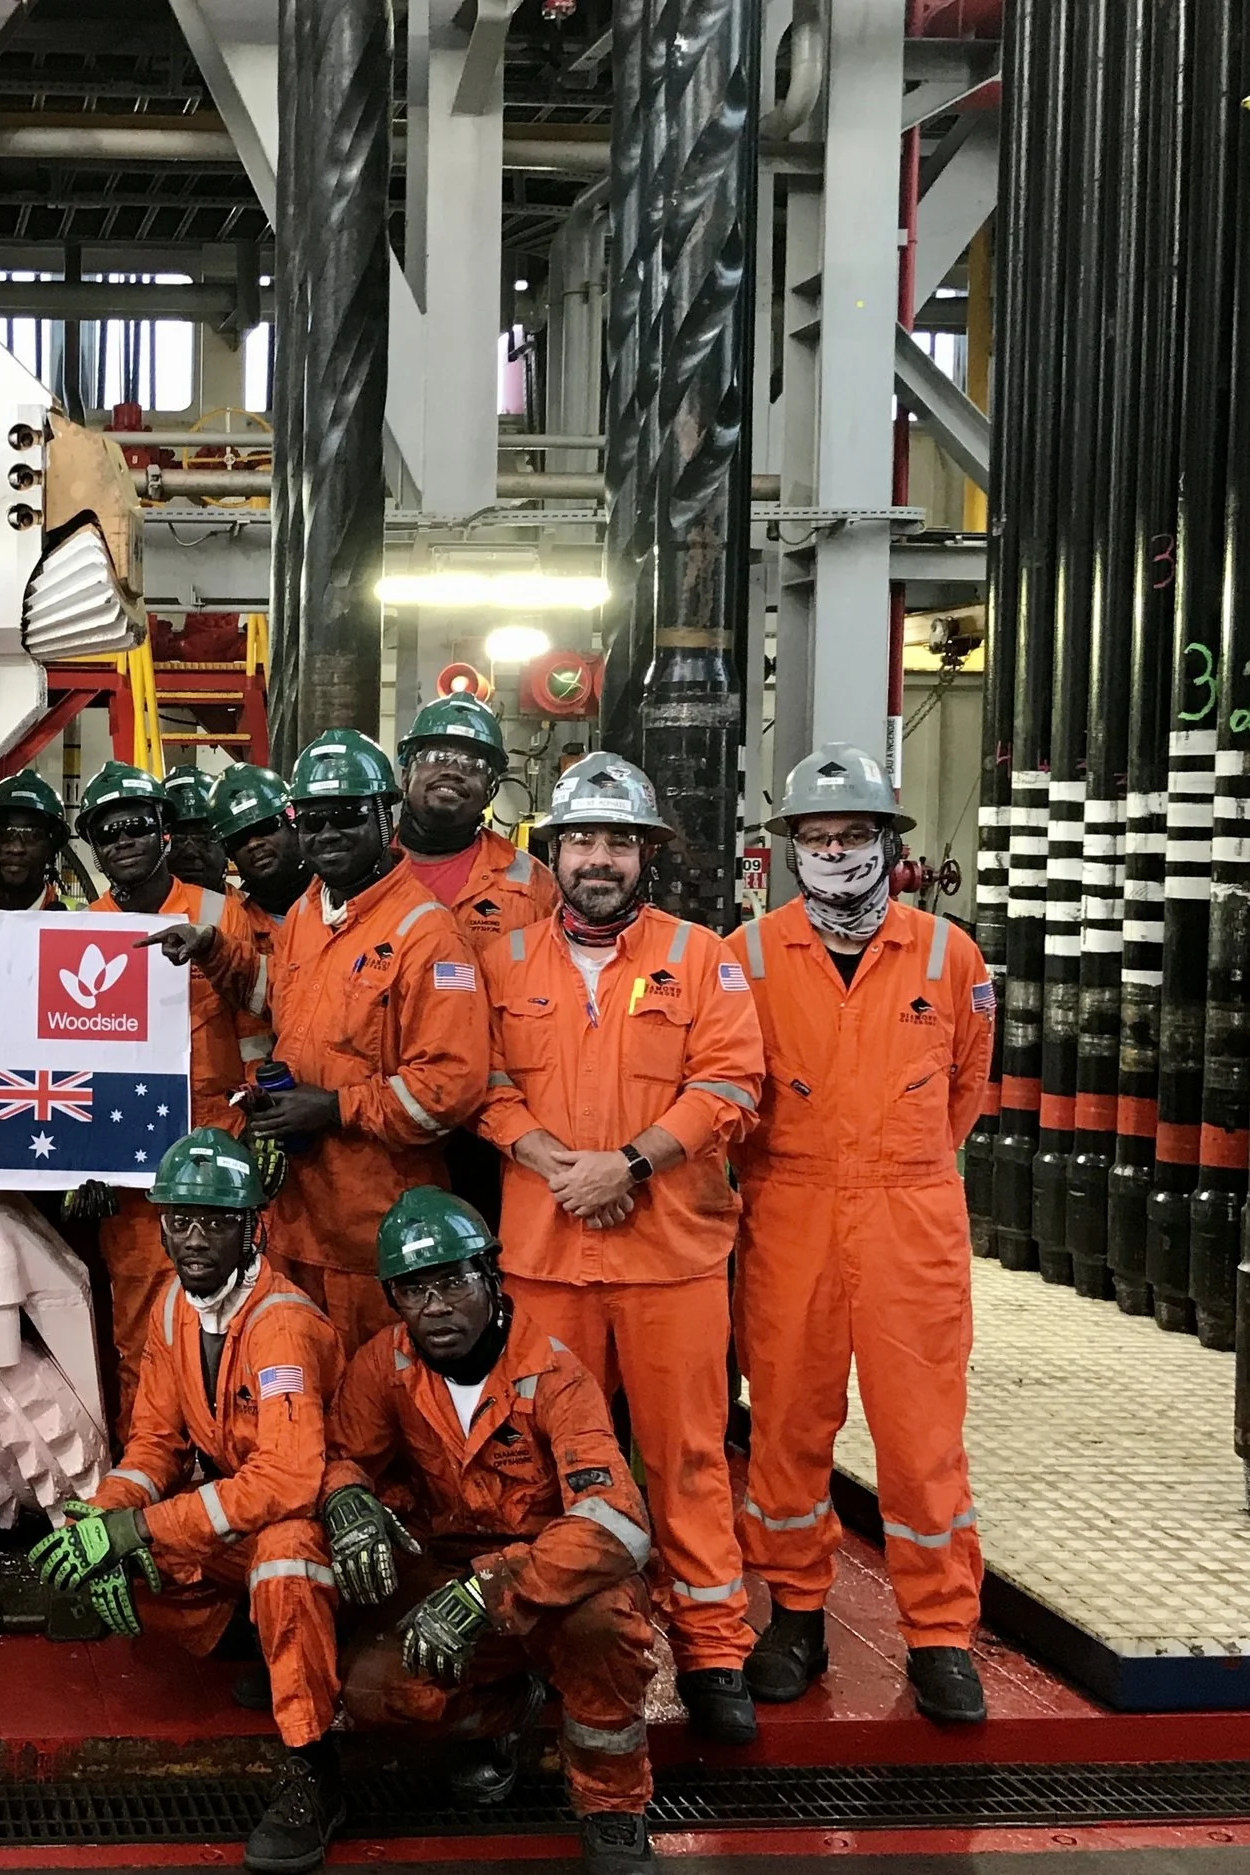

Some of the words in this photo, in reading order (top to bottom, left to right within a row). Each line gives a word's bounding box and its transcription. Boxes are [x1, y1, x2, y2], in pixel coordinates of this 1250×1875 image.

[1151, 533, 1175, 589] 3
[1177, 642, 1216, 721] 3
[47, 1012, 139, 1031] Woodside
[493, 1449, 530, 1460] DIAMOND
